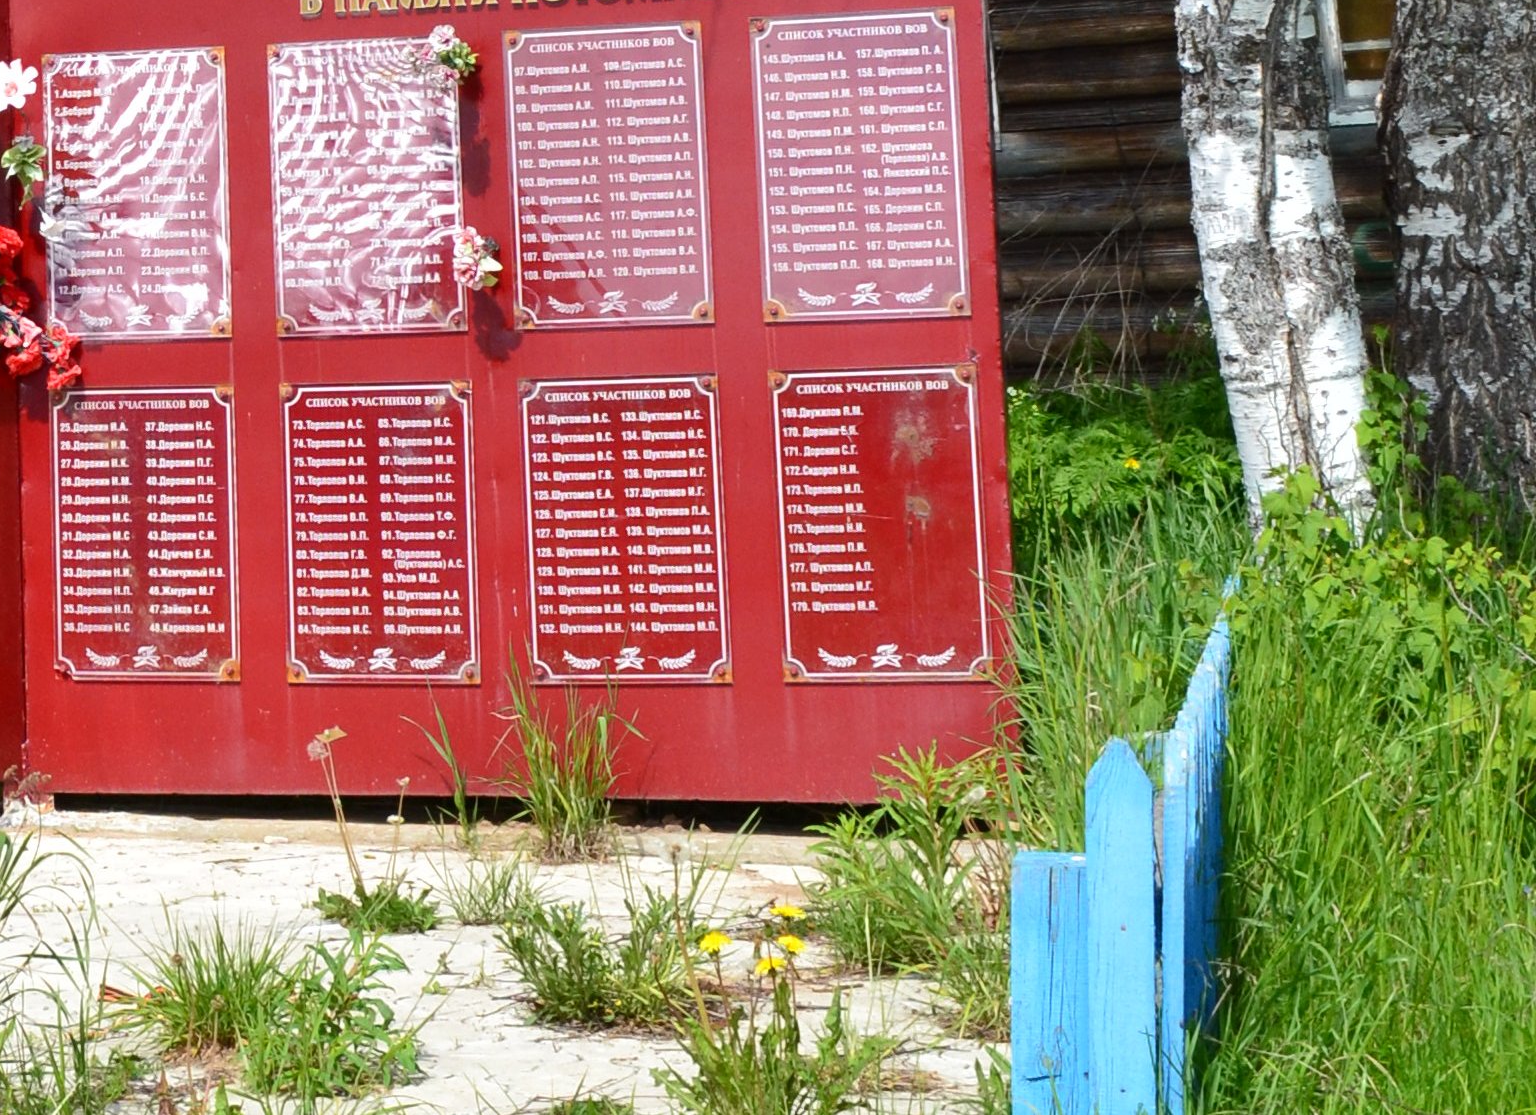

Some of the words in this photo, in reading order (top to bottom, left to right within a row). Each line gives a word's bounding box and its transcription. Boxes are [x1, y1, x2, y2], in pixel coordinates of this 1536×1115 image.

[777, 28, 823, 41] СПИСОК
[826, 24, 901, 38] УЧАСТНИКОВ
[904, 23, 928, 34] ВОВ
[529, 41, 574, 53] СПИСОК
[576, 38, 649, 51] УЧАСТНИКОВ
[652, 37, 674, 48] ВОВ
[795, 383, 843, 395] СПИСОК
[846, 381, 922, 393] УЧАСТНИКОВ
[925, 380, 948, 390] ВОВ
[305, 397, 348, 408] СПИСОК
[351, 395, 421, 407] УЧАСТНИКОВ
[424, 395, 445, 405] ВОВ
[544, 391, 590, 402] СПИСОК
[592, 389, 665, 401] УЧАСТНИКОВ
[668, 388, 691, 399] ВОВ
[74, 400, 115, 410] СПИСОК
[118, 399, 186, 410] УЧАСТНИКОВ
[189, 399, 209, 409] ВОВ
